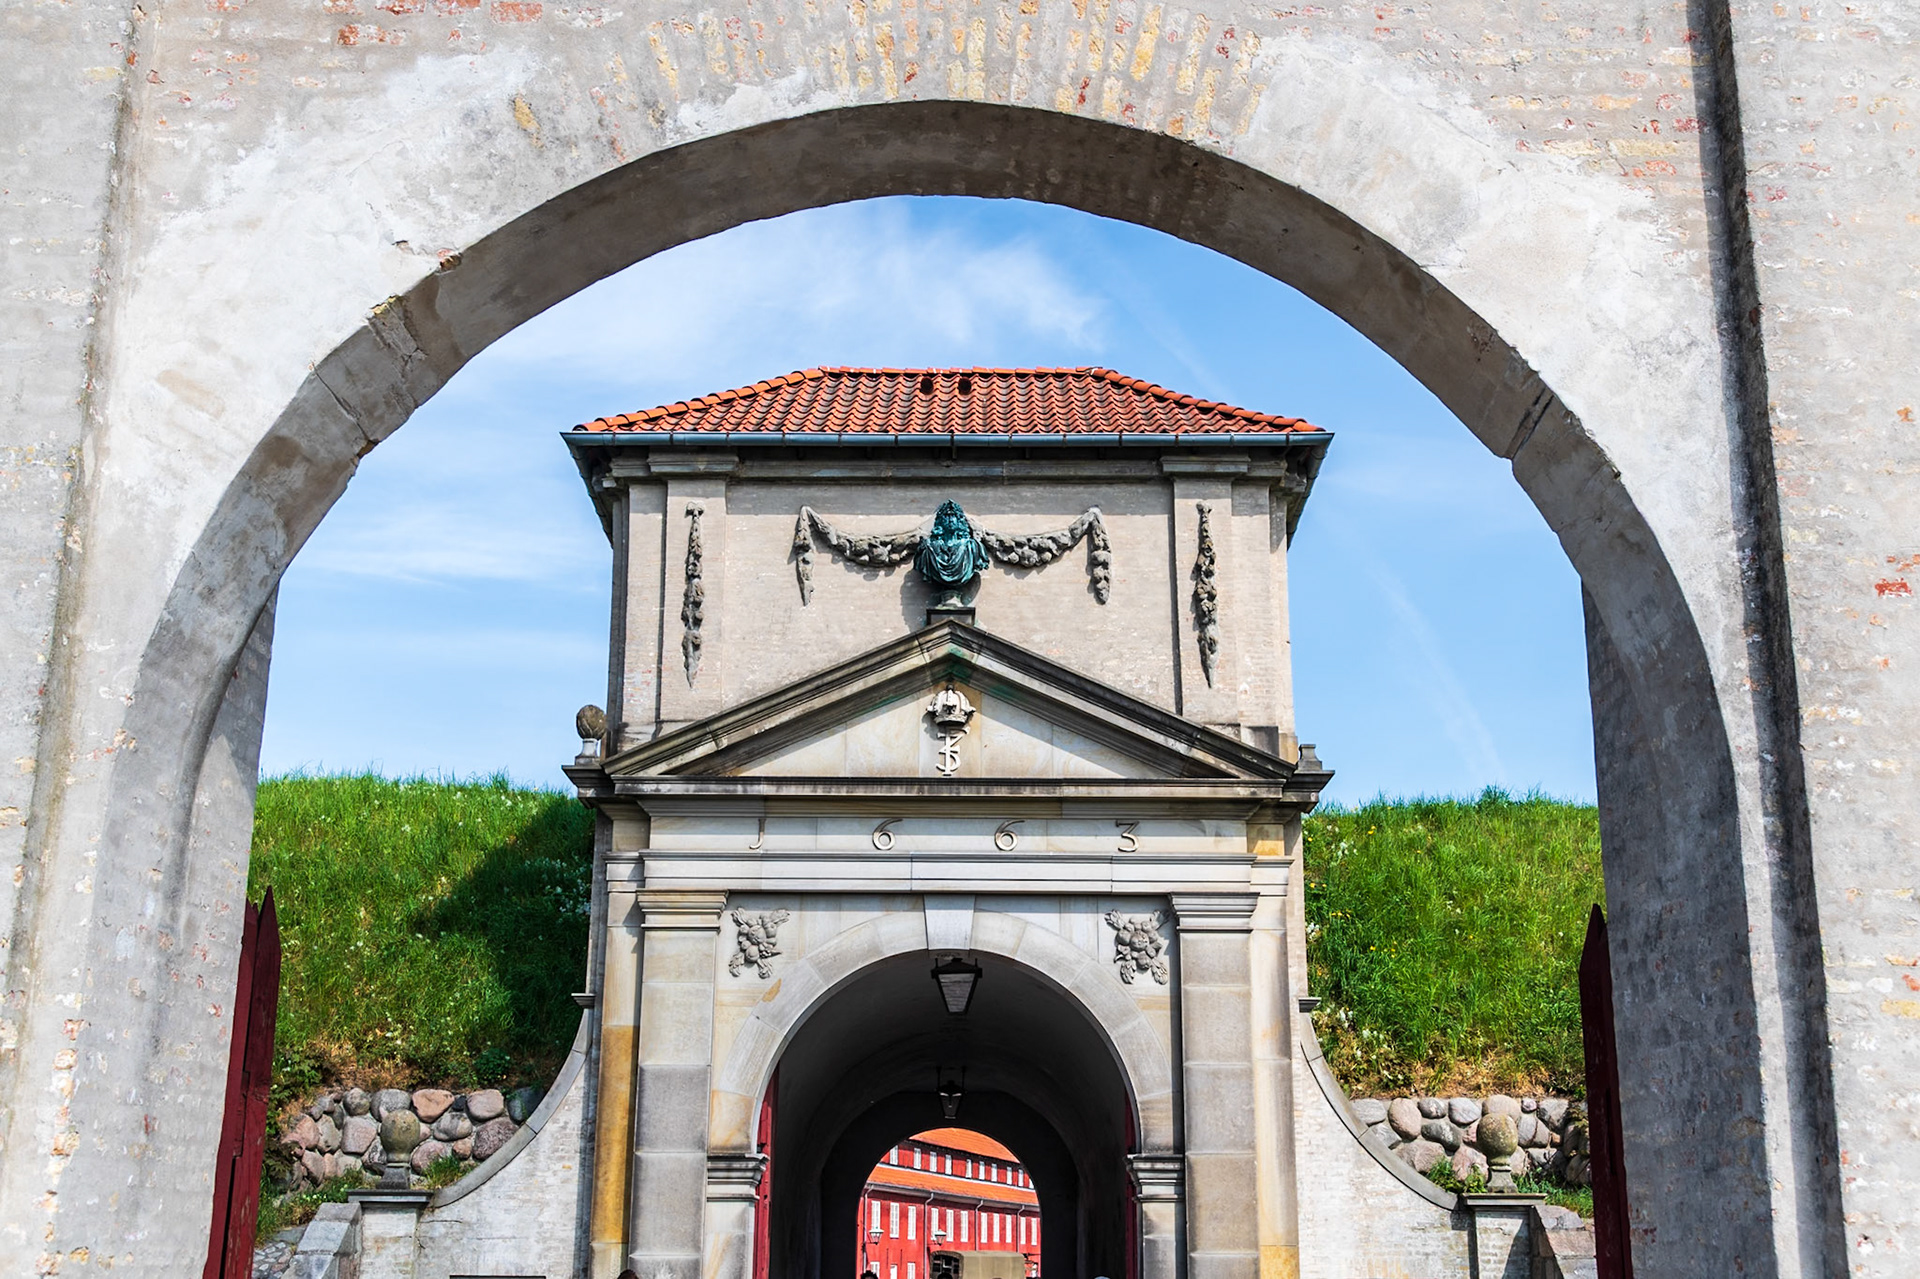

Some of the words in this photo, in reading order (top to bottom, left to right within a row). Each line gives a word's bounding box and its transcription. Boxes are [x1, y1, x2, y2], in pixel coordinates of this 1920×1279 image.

[872, 818, 903, 851] 6
[994, 819, 1025, 852] 6
[1115, 819, 1140, 853] 3
